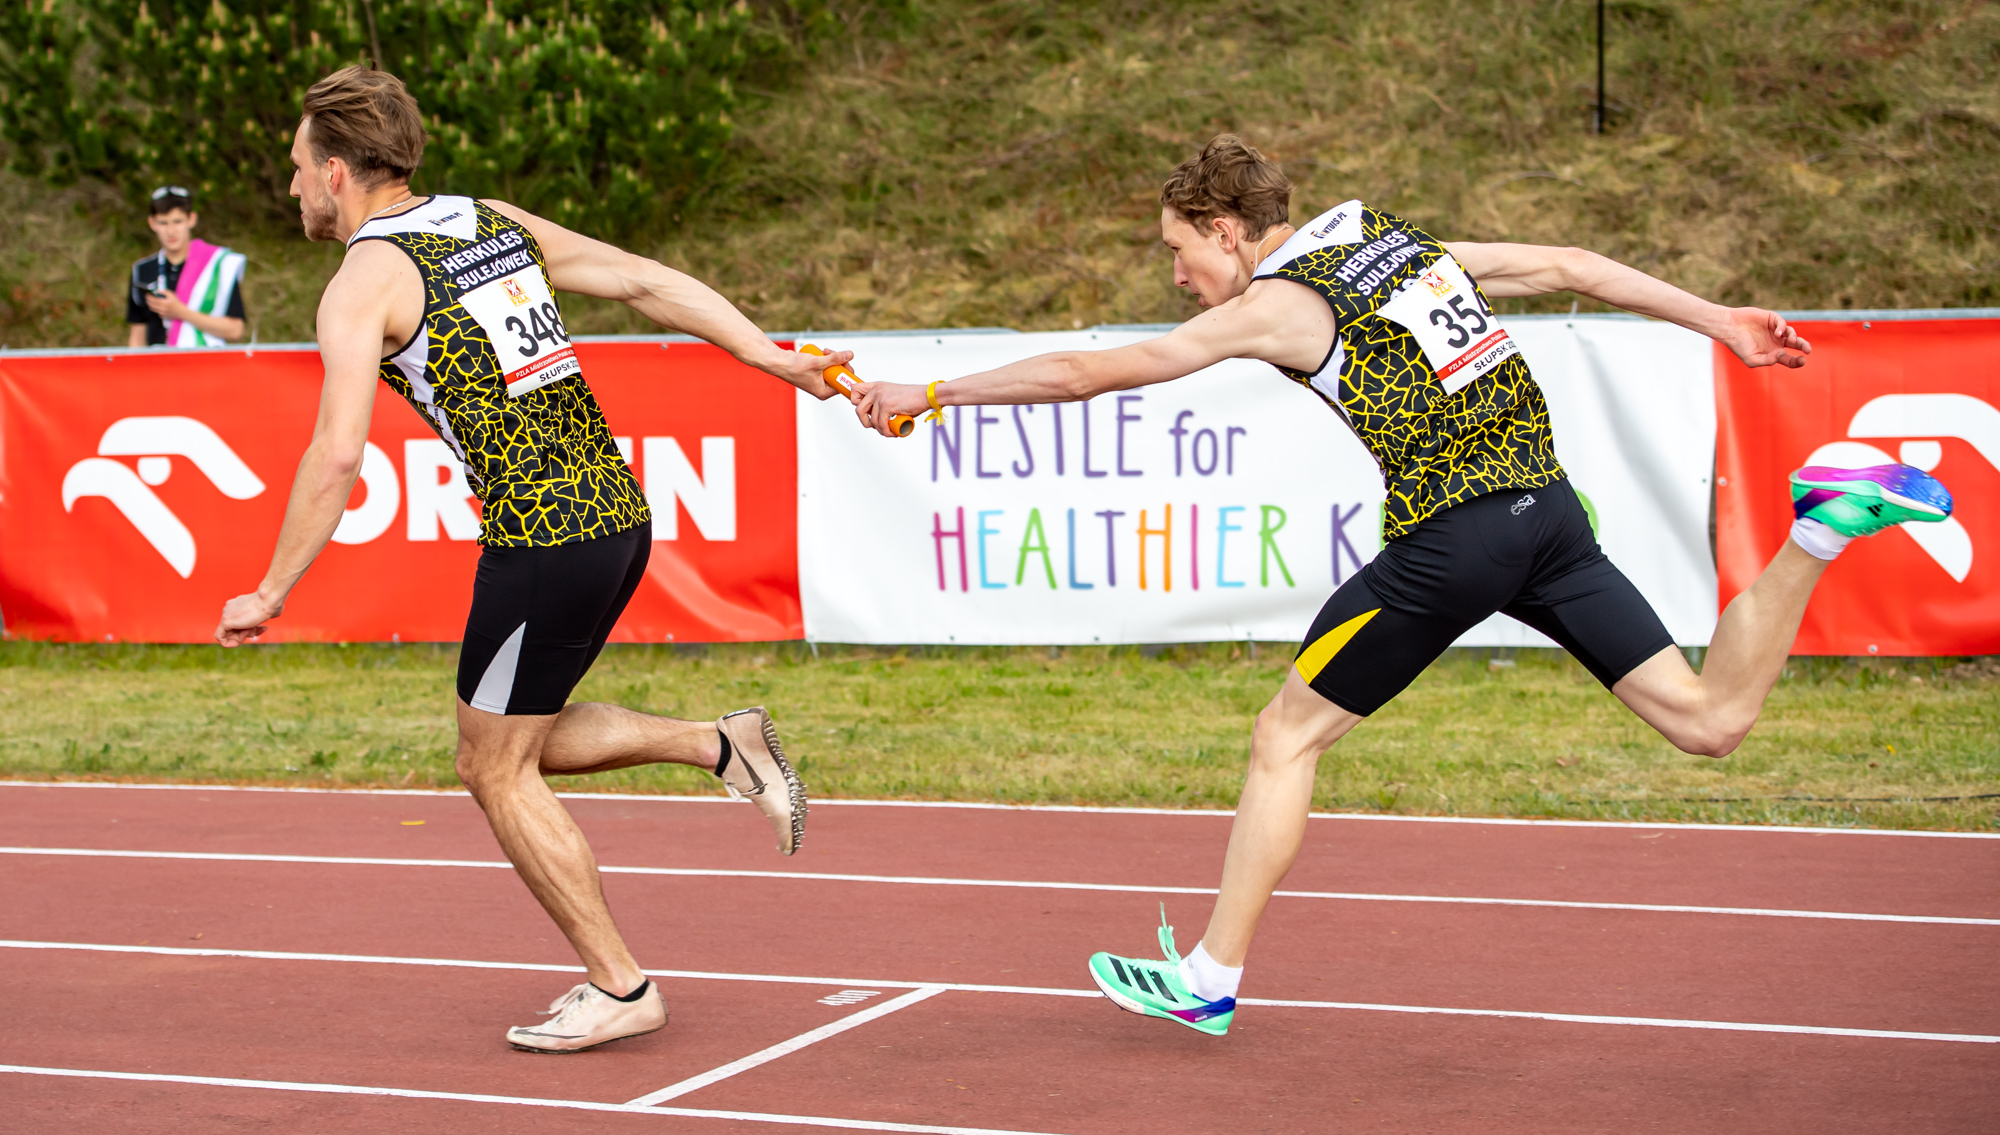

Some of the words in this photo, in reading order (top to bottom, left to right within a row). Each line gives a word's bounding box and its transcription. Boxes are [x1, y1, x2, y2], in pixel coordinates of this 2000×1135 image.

[441, 230, 524, 275] HERKULES
[456, 248, 533, 290] SULEJÓWEK
[1335, 230, 1409, 284] HERKULES
[504, 302, 569, 358] 348
[539, 361, 572, 383] SŁUPSK
[1473, 344, 1509, 371] SŁUPSK
[1168, 410, 1247, 477] for
[331, 436, 737, 546] ORN
[931, 503, 1296, 593] HEALTHIER
